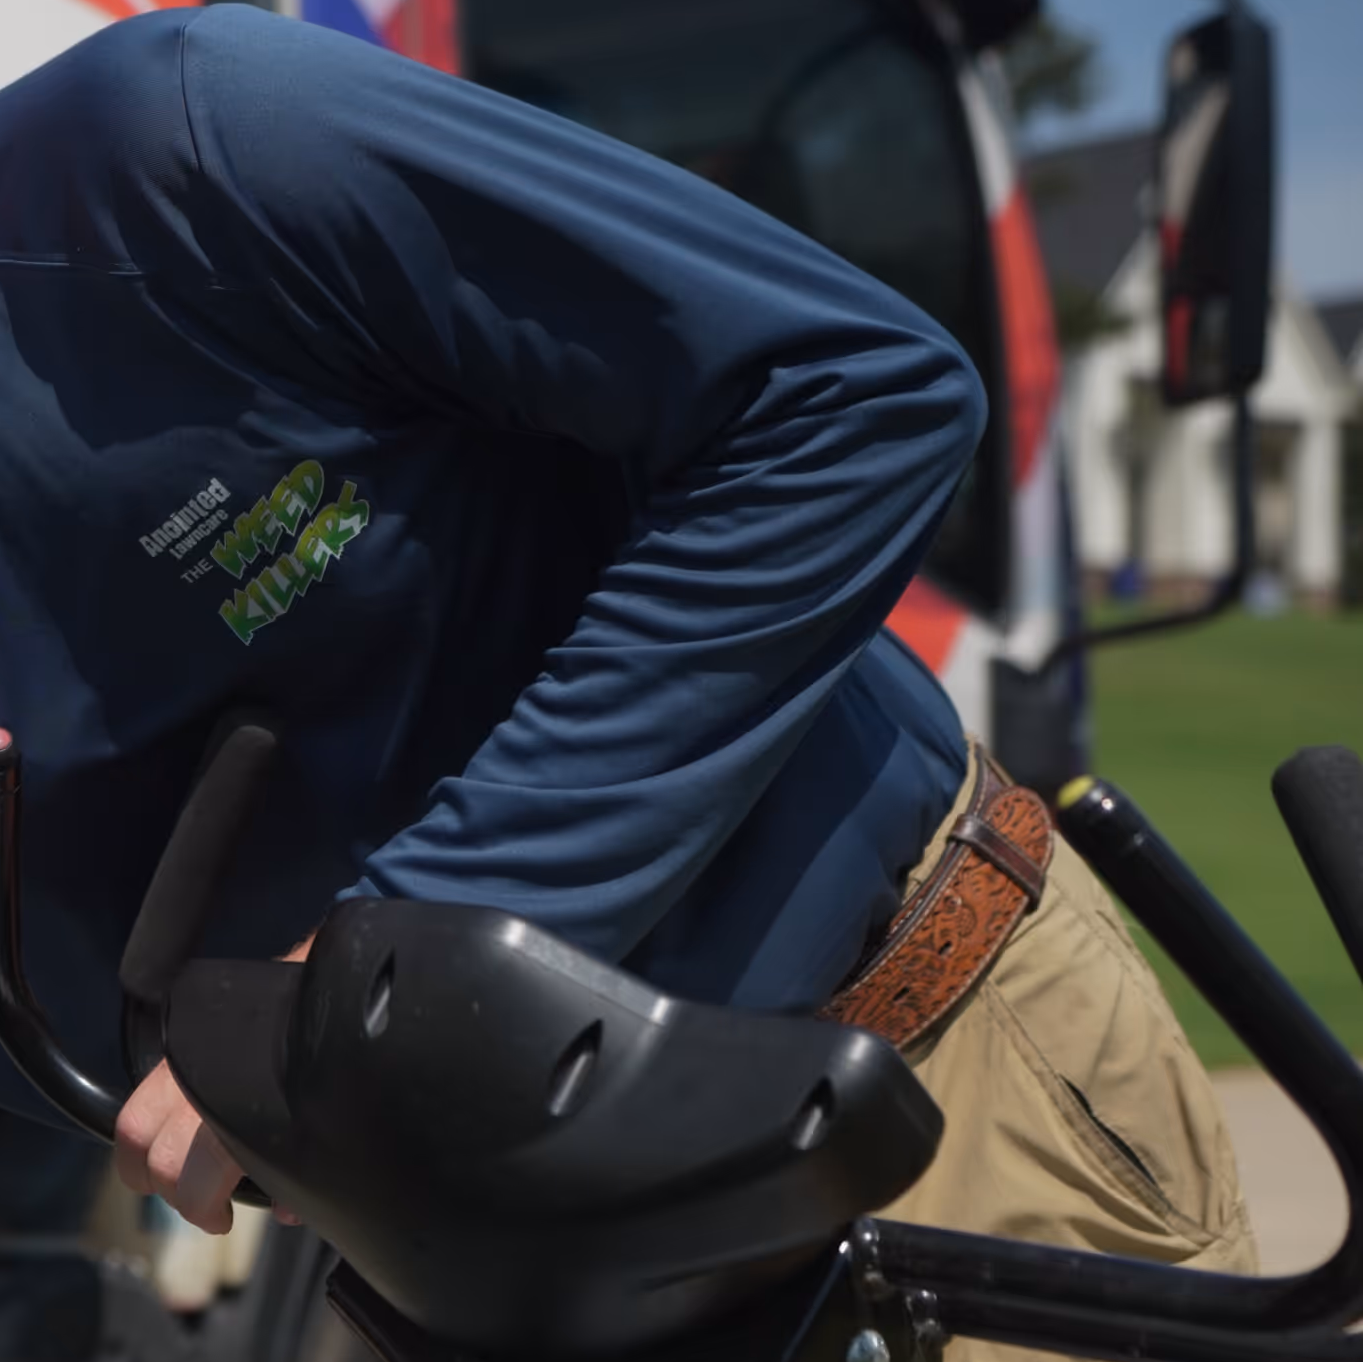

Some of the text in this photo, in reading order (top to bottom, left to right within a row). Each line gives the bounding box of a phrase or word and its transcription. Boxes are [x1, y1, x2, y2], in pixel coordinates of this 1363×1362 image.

[138, 477, 231, 557] Anointed
[180, 459, 325, 584] THE WEED
[217, 480, 370, 646] KILLERS
